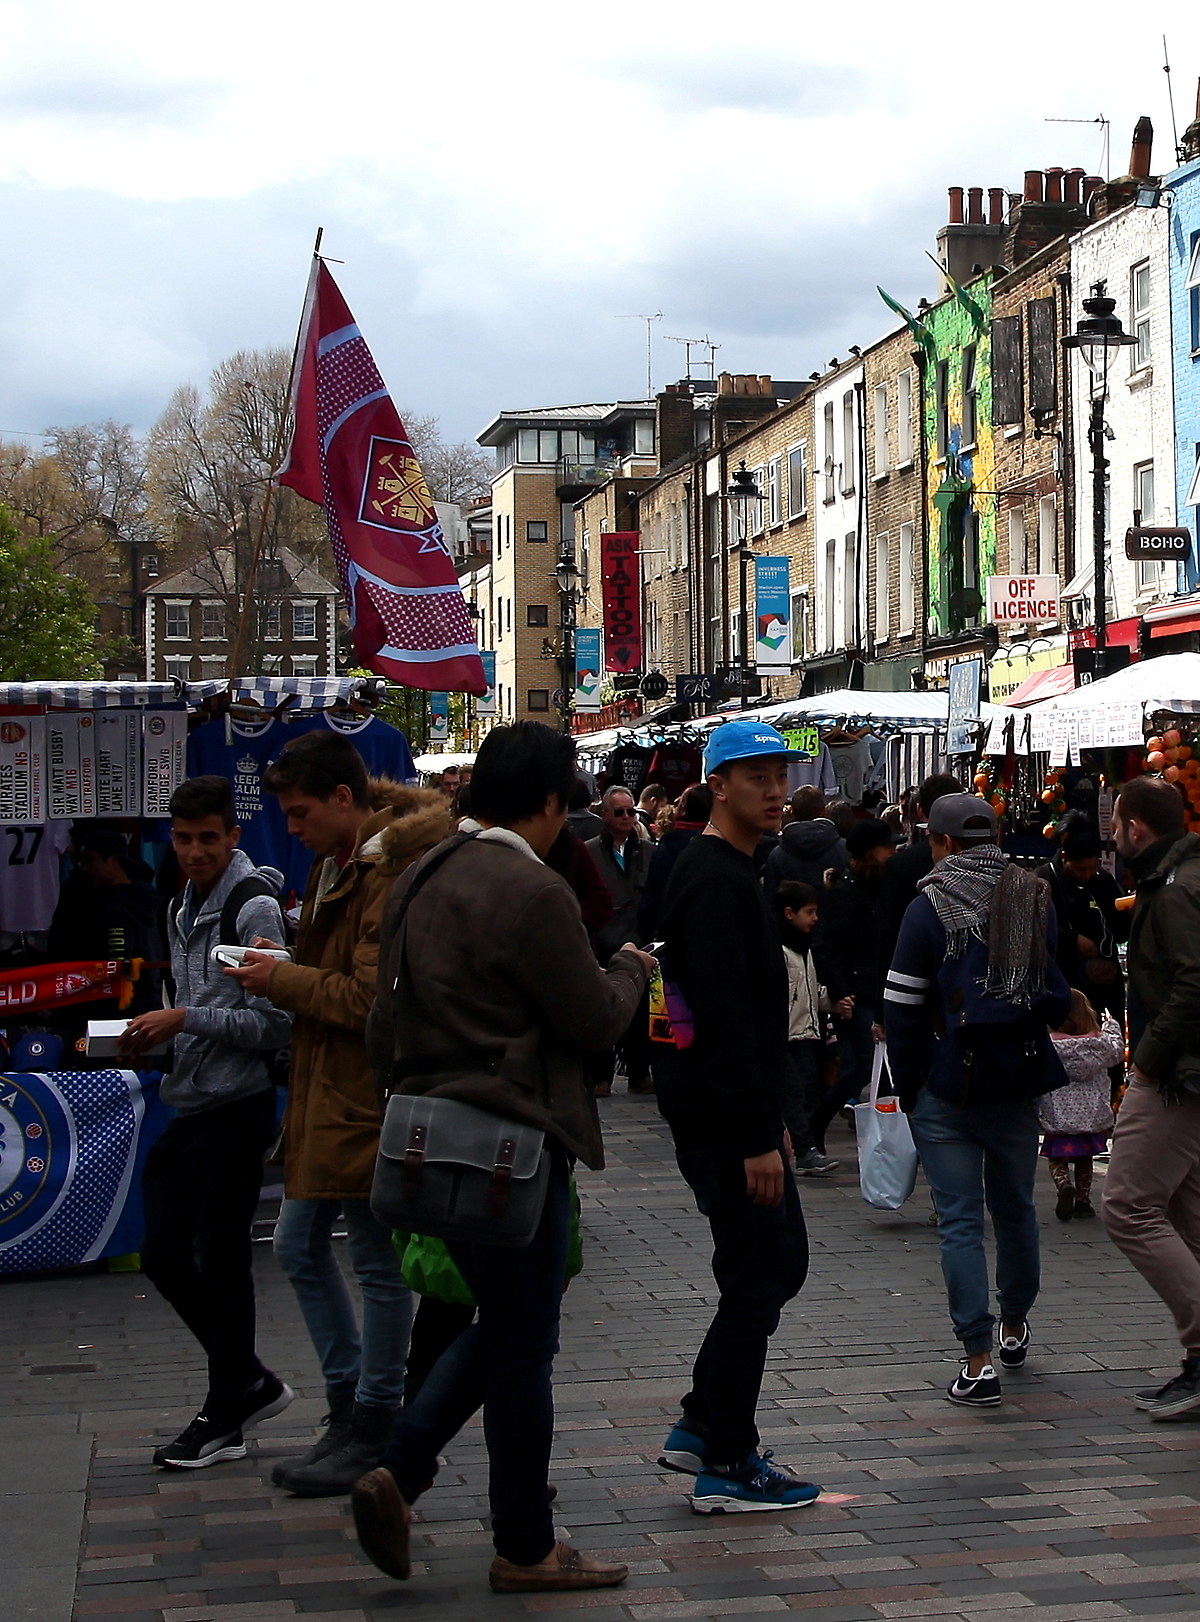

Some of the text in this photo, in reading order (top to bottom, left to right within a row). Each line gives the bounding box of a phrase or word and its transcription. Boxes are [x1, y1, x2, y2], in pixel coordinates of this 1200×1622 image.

[606, 538, 635, 553] ASK
[1140, 536, 1185, 549] BOHO
[609, 555, 634, 636] TATTOO
[994, 600, 1057, 619] LICENCE
[1008, 579, 1036, 598] OFF
[924, 659, 947, 678] MADE
[0, 763, 13, 820] EMIRATES
[14, 751, 28, 820] STADIUM N5
[50, 729, 66, 815] SIR MATT BUSBY
[65, 769, 79, 815] WAY M16
[82, 757, 93, 814] OLD TRAFFORD
[99, 749, 111, 812] WHITE HART
[111, 764, 123, 812] LANE N17
[147, 758, 159, 813] STAMFORD
[158, 748, 170, 813] BRIDGE SW6
[6, 826, 44, 866] 27
